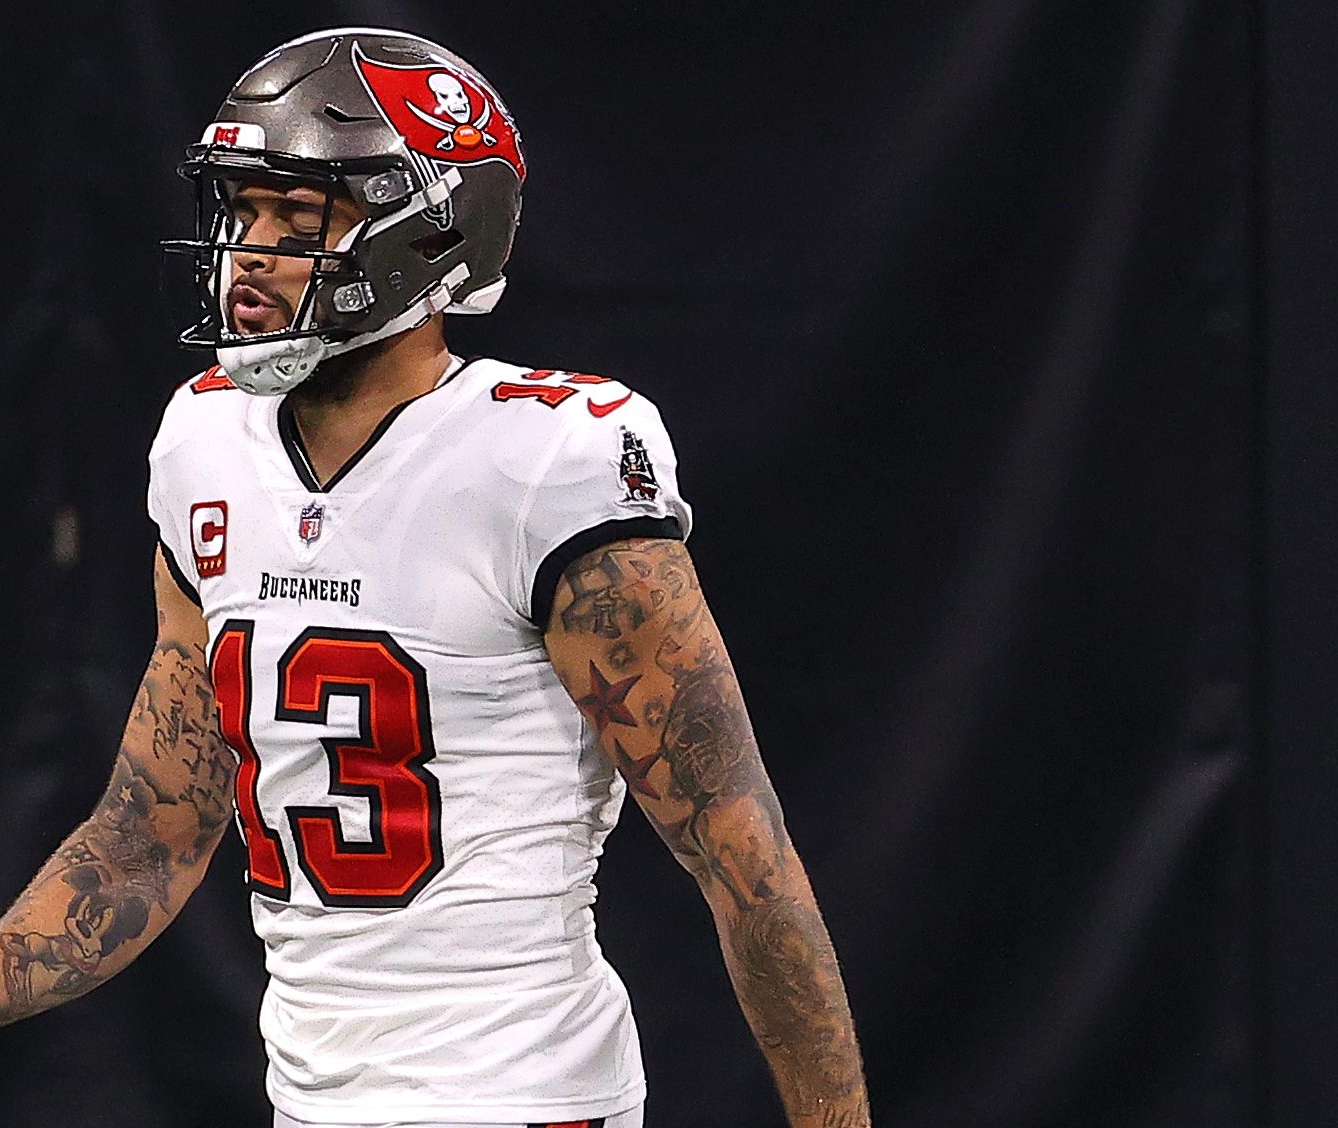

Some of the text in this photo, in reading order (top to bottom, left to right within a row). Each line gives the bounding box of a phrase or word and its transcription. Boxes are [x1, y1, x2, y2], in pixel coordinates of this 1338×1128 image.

[192, 507, 224, 557] C
[258, 572, 361, 607] BUCCANEERS
[209, 619, 444, 908] 13
